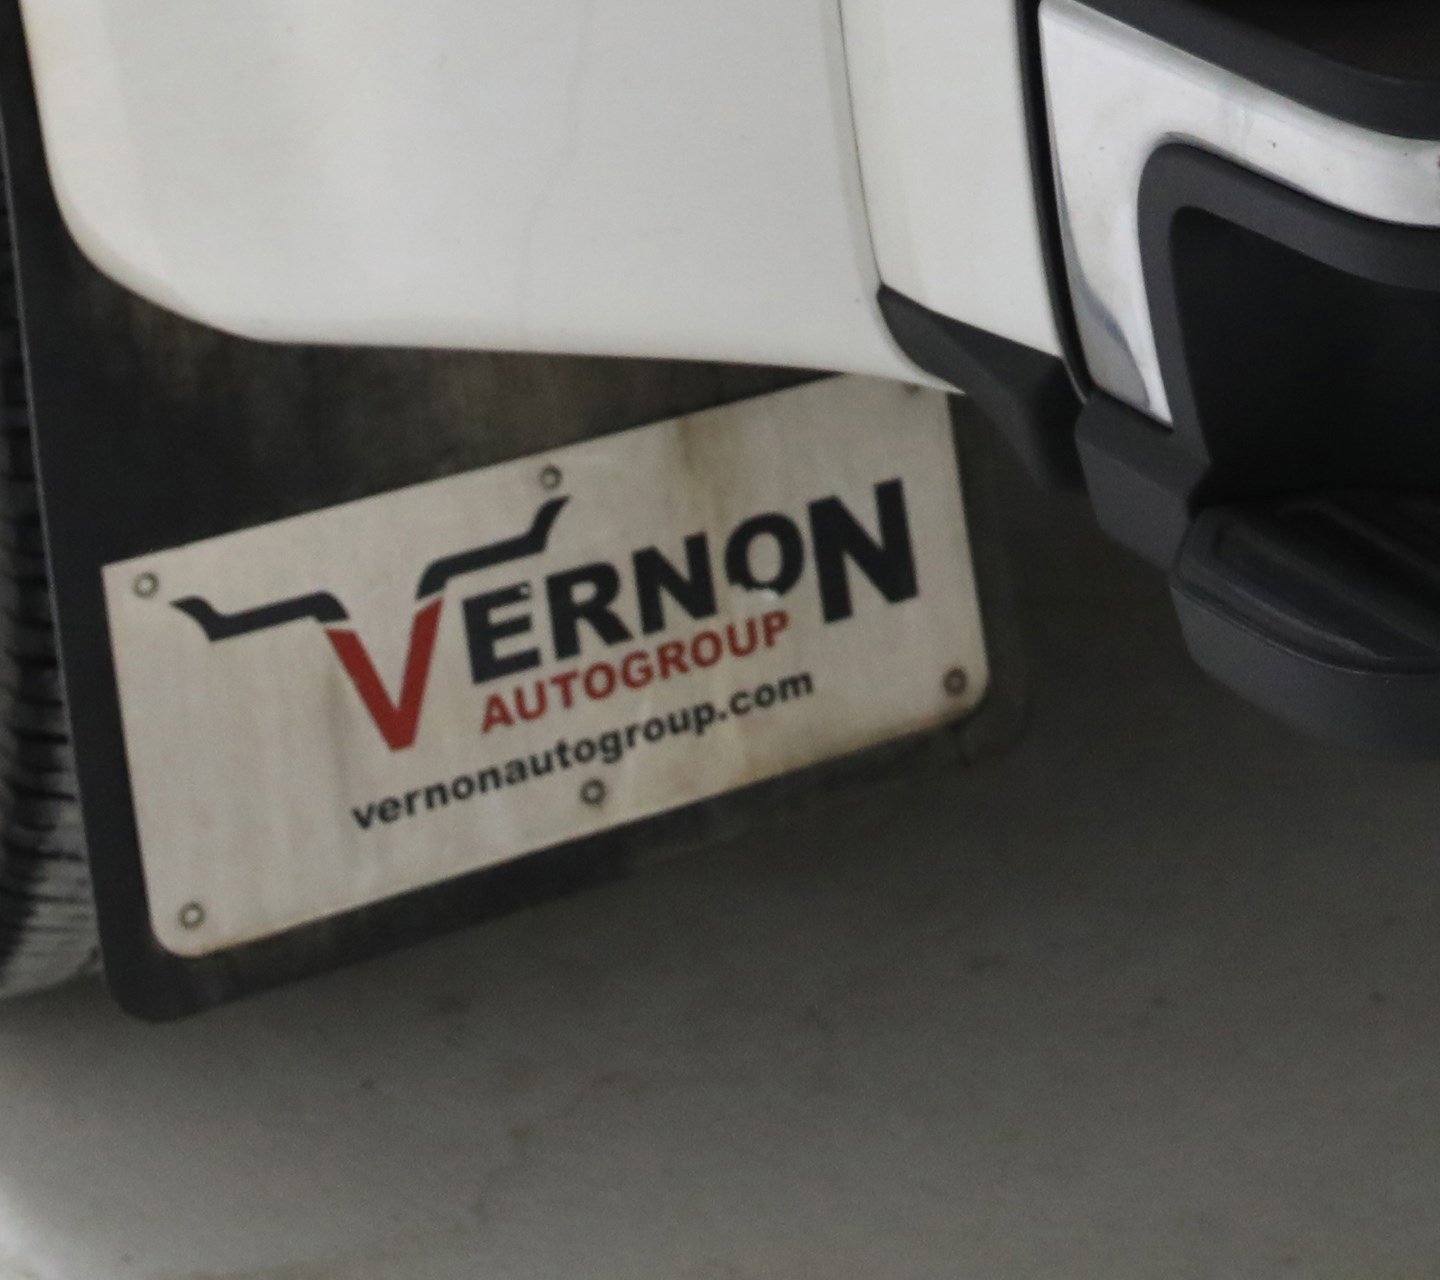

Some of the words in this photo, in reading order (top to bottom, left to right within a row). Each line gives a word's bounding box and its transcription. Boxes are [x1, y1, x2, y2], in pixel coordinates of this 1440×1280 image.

[326, 478, 920, 753] VERNON
[480, 609, 792, 735] AUTOGROUP
[351, 670, 815, 832] vernonautogroup.com
